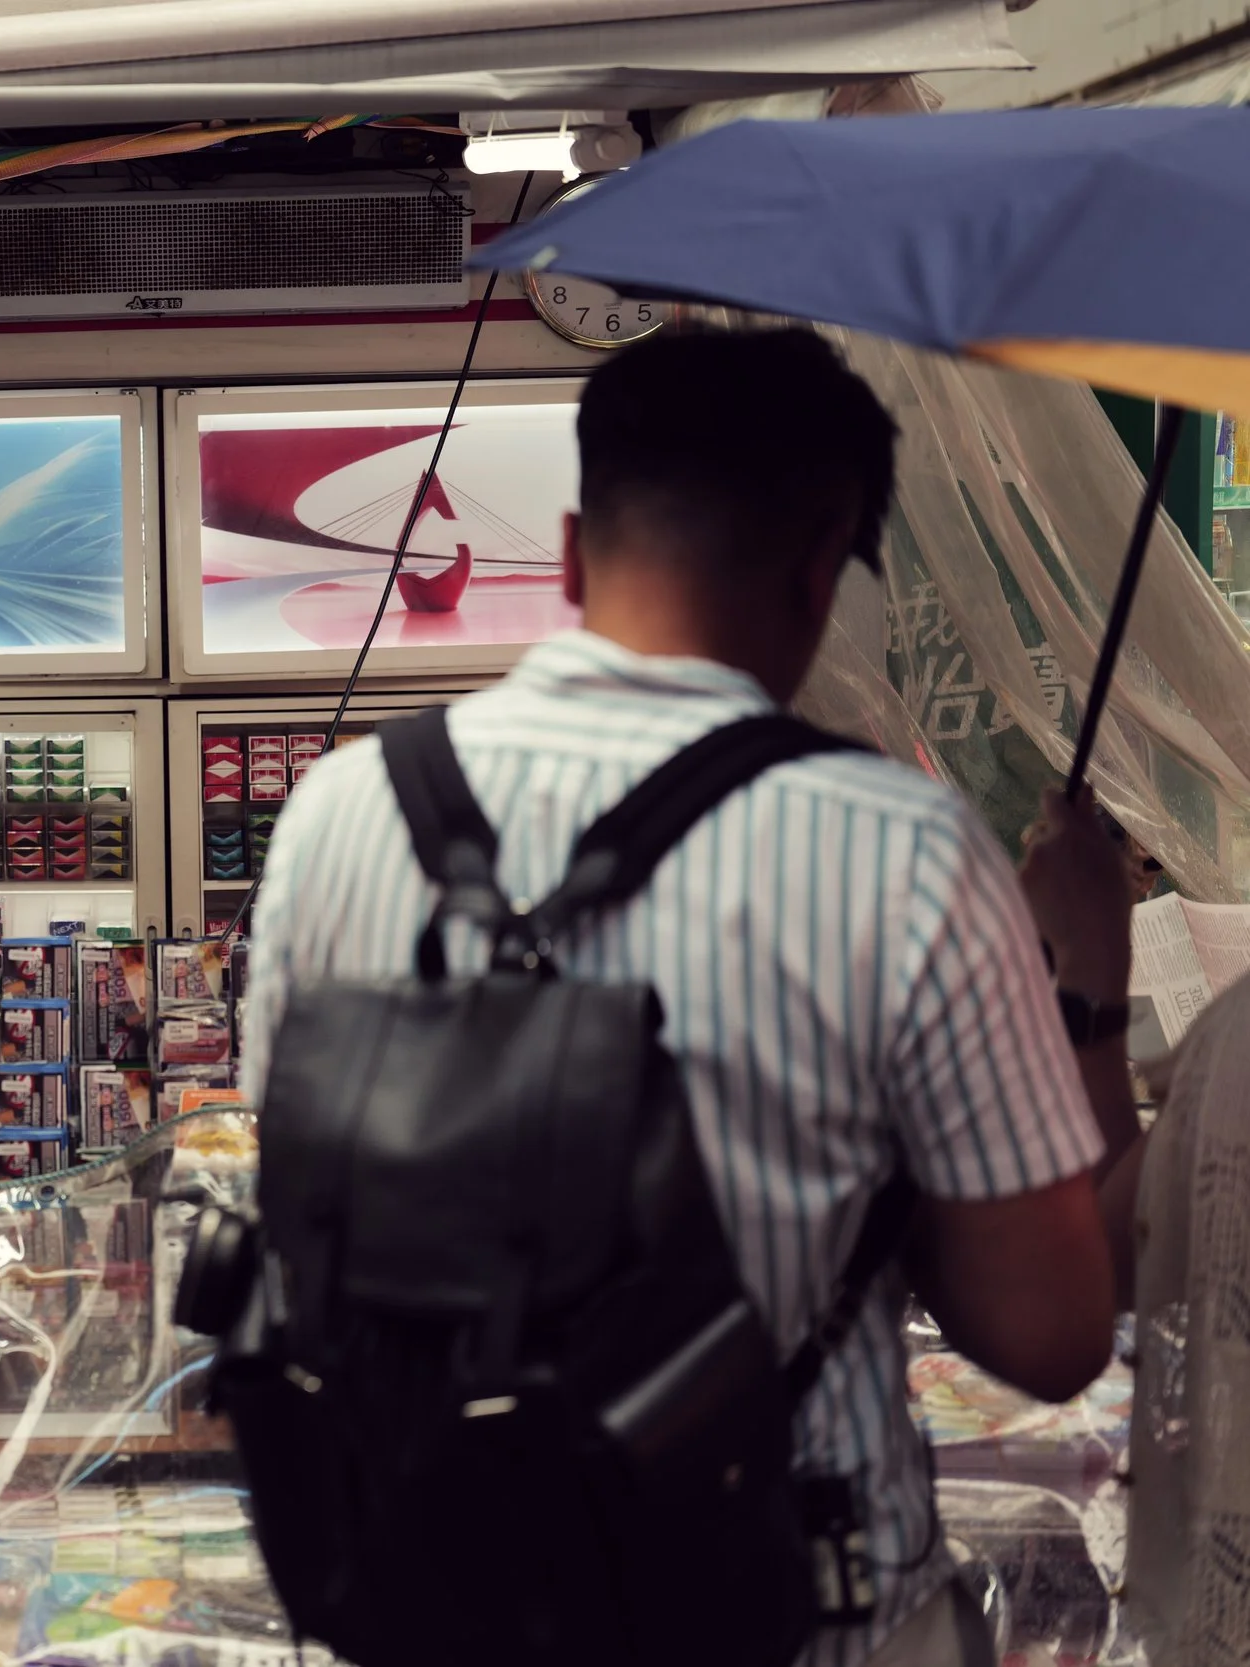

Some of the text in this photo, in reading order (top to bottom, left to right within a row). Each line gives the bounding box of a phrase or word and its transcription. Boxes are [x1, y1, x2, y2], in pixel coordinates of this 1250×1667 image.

[552, 286, 567, 304] 8
[575, 307, 590, 325] 7
[637, 304, 652, 322] 5
[605, 314, 621, 332] 6
[53, 921, 79, 936] NEXT
